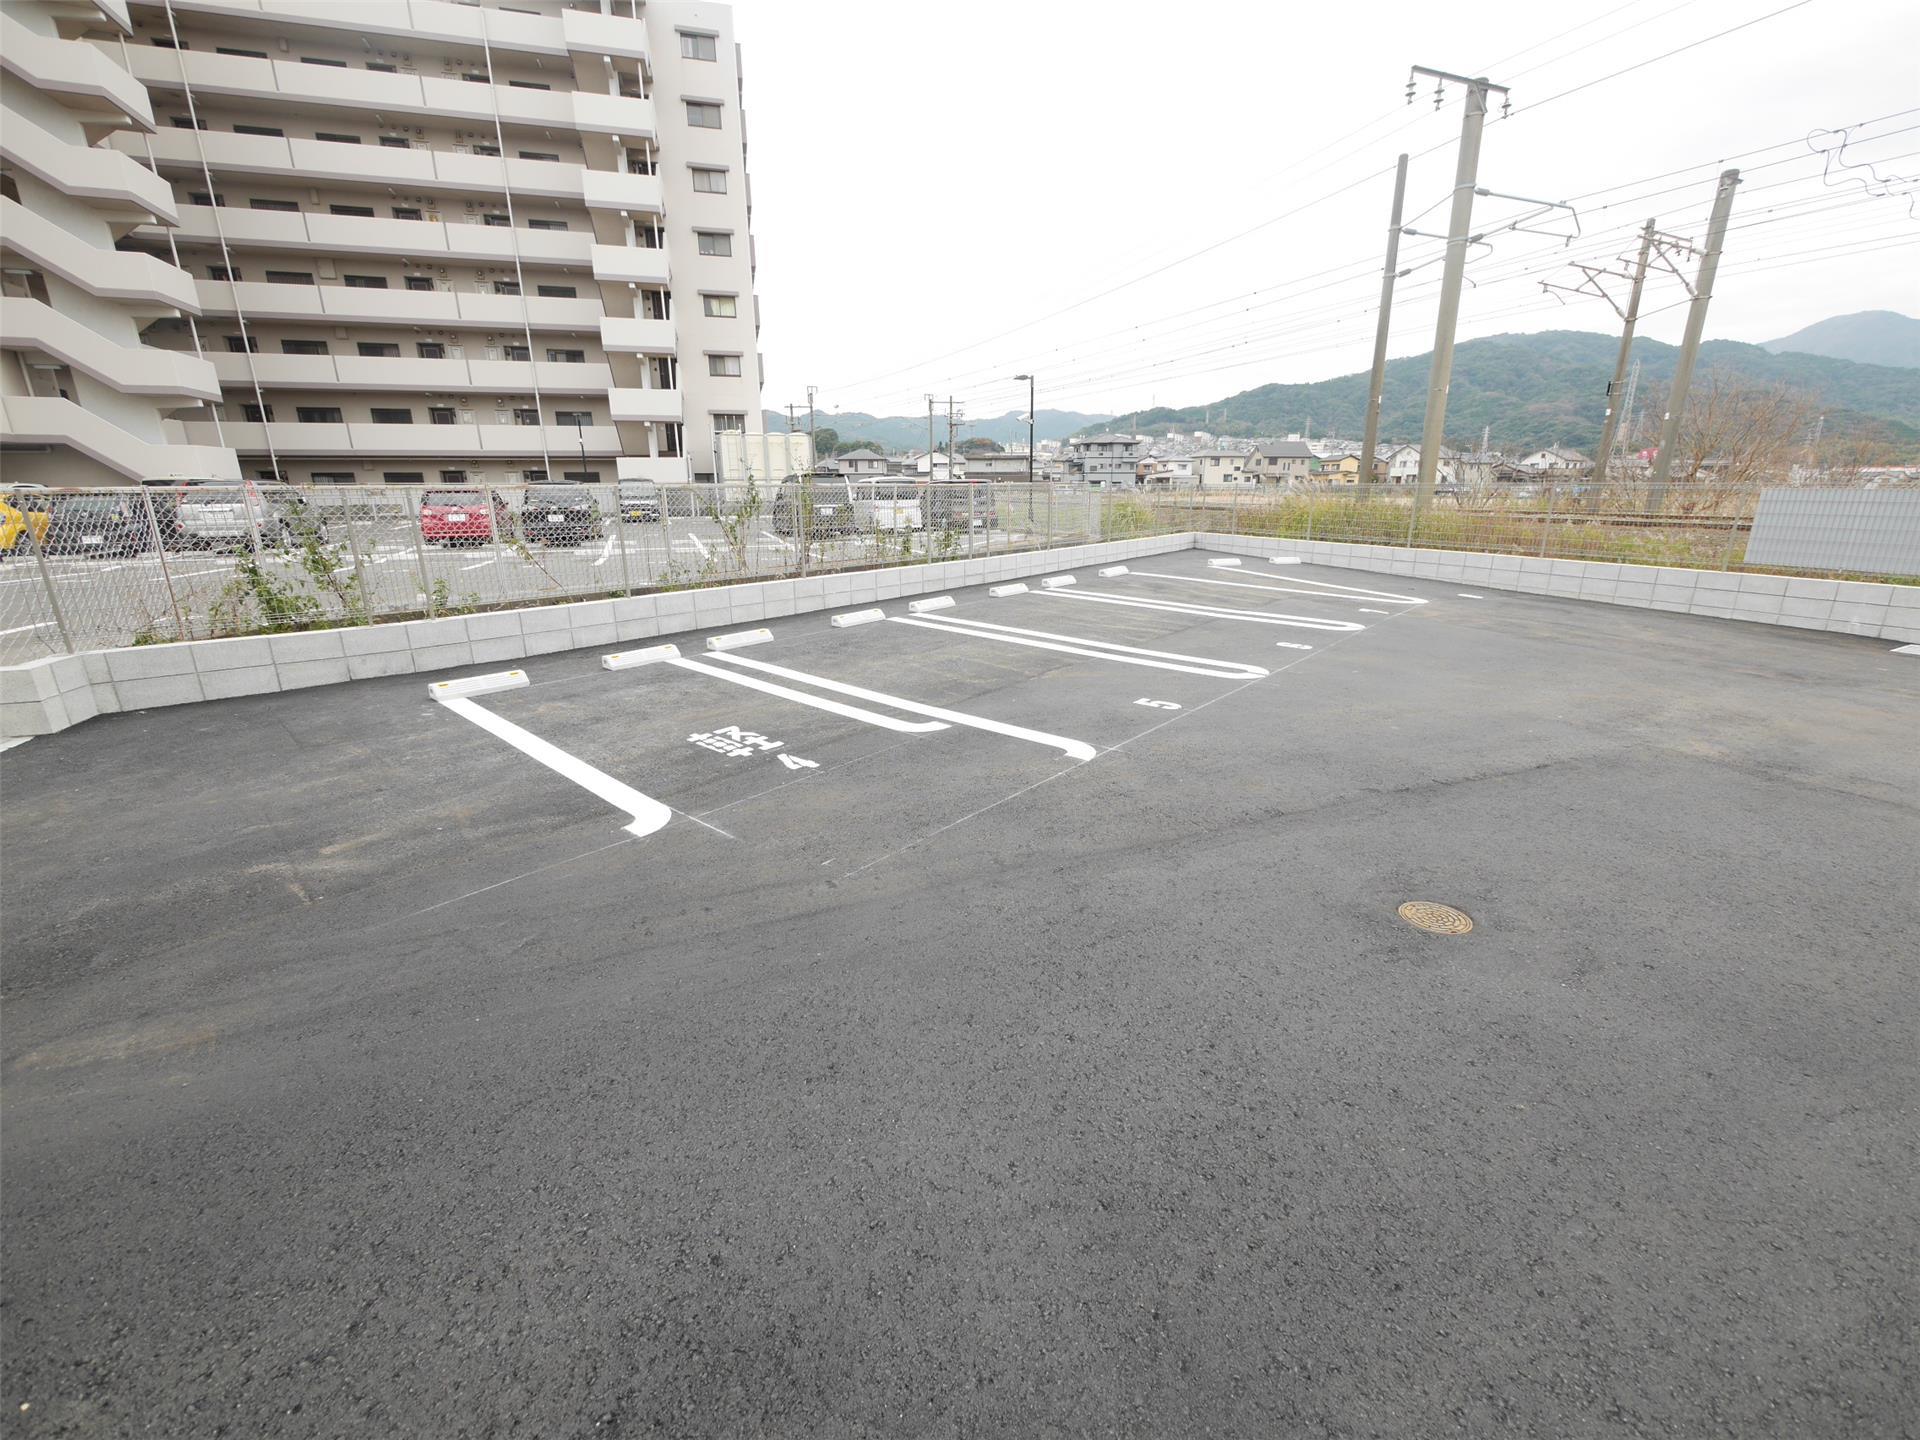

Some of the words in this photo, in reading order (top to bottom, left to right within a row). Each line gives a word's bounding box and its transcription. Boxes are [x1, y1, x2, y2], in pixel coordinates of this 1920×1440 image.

[1132, 697, 1182, 710] 5
[686, 725, 785, 757] 軽
[777, 753, 821, 770] 4
